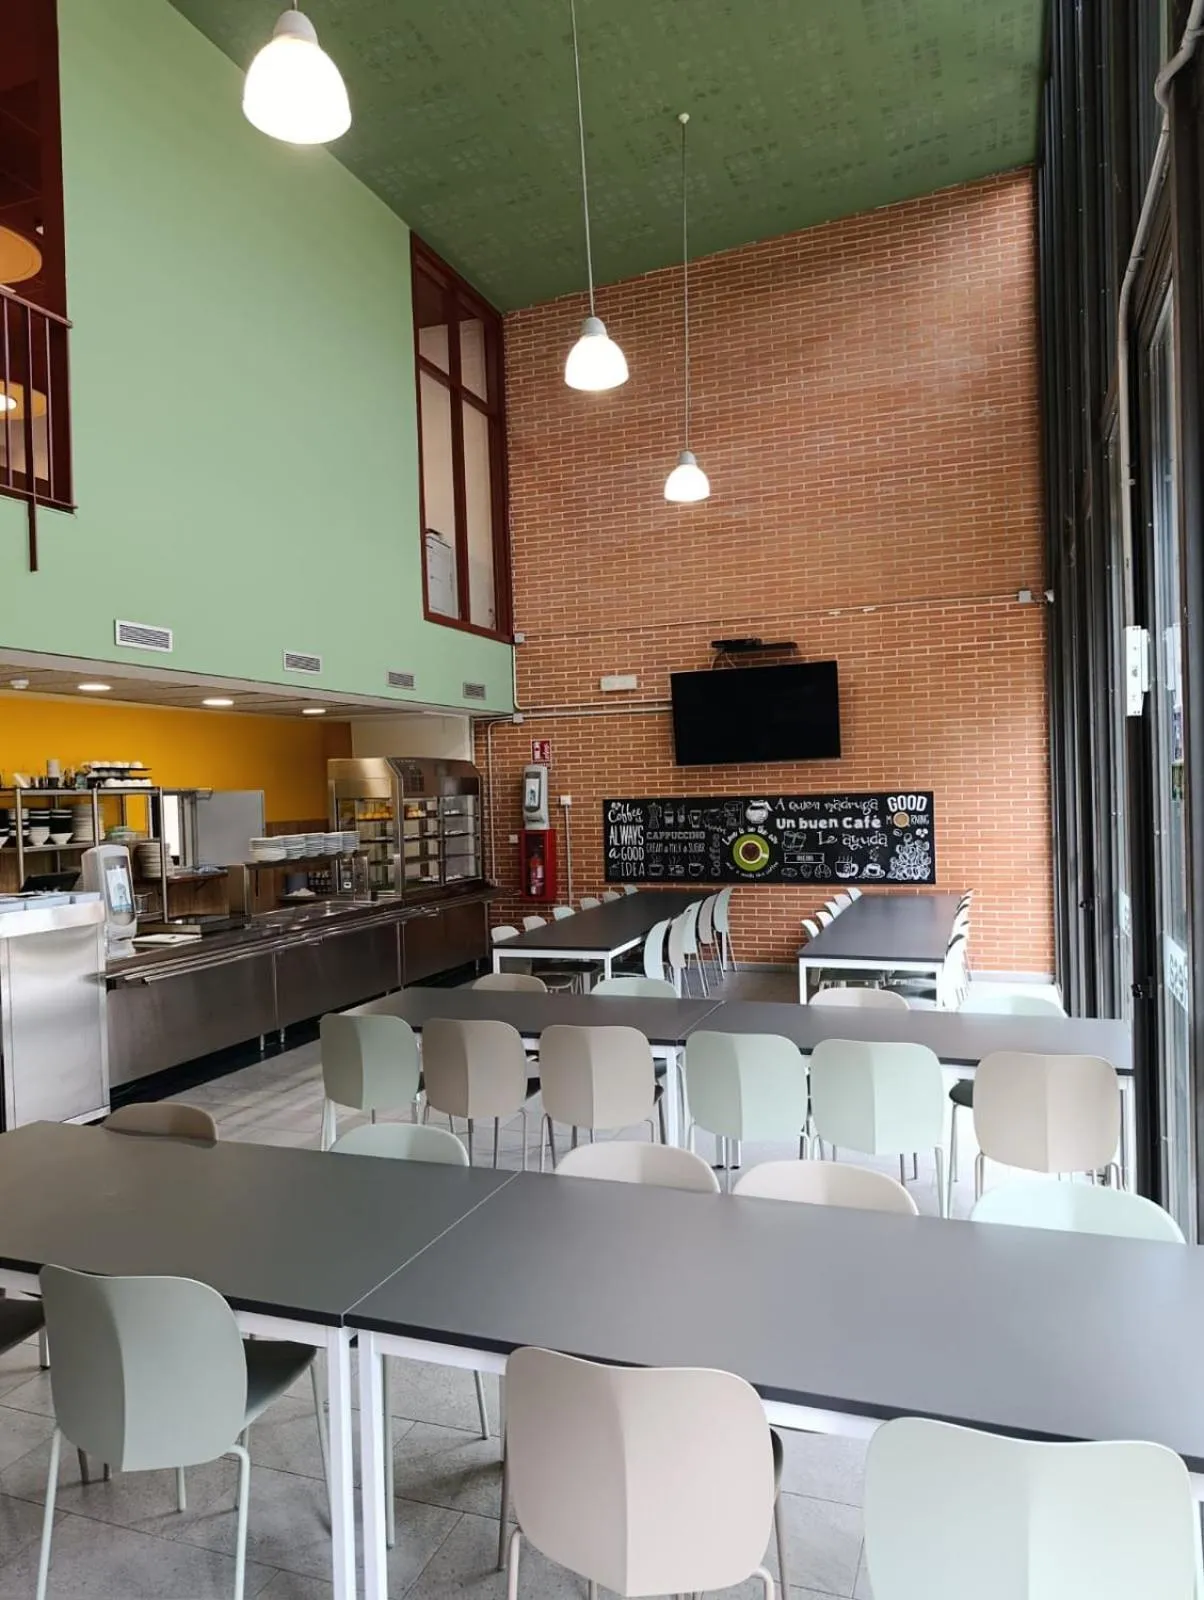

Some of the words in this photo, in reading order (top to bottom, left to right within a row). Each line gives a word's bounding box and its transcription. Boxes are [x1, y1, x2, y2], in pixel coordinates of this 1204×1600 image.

[775, 798, 785, 811] A
[887, 795, 927, 812] GOOD
[776, 817, 796, 829] Un
[799, 816, 839, 829] buen
[842, 815, 881, 829] Café
[609, 825, 644, 846] ALWAYS
[646, 831, 706, 840] CAPPUCCINO
[816, 831, 838, 845] Le
[842, 831, 888, 850] ayuda
[609, 848, 621, 859] a
[621, 847, 645, 861] GOOD
[621, 862, 645, 877] IDEA
